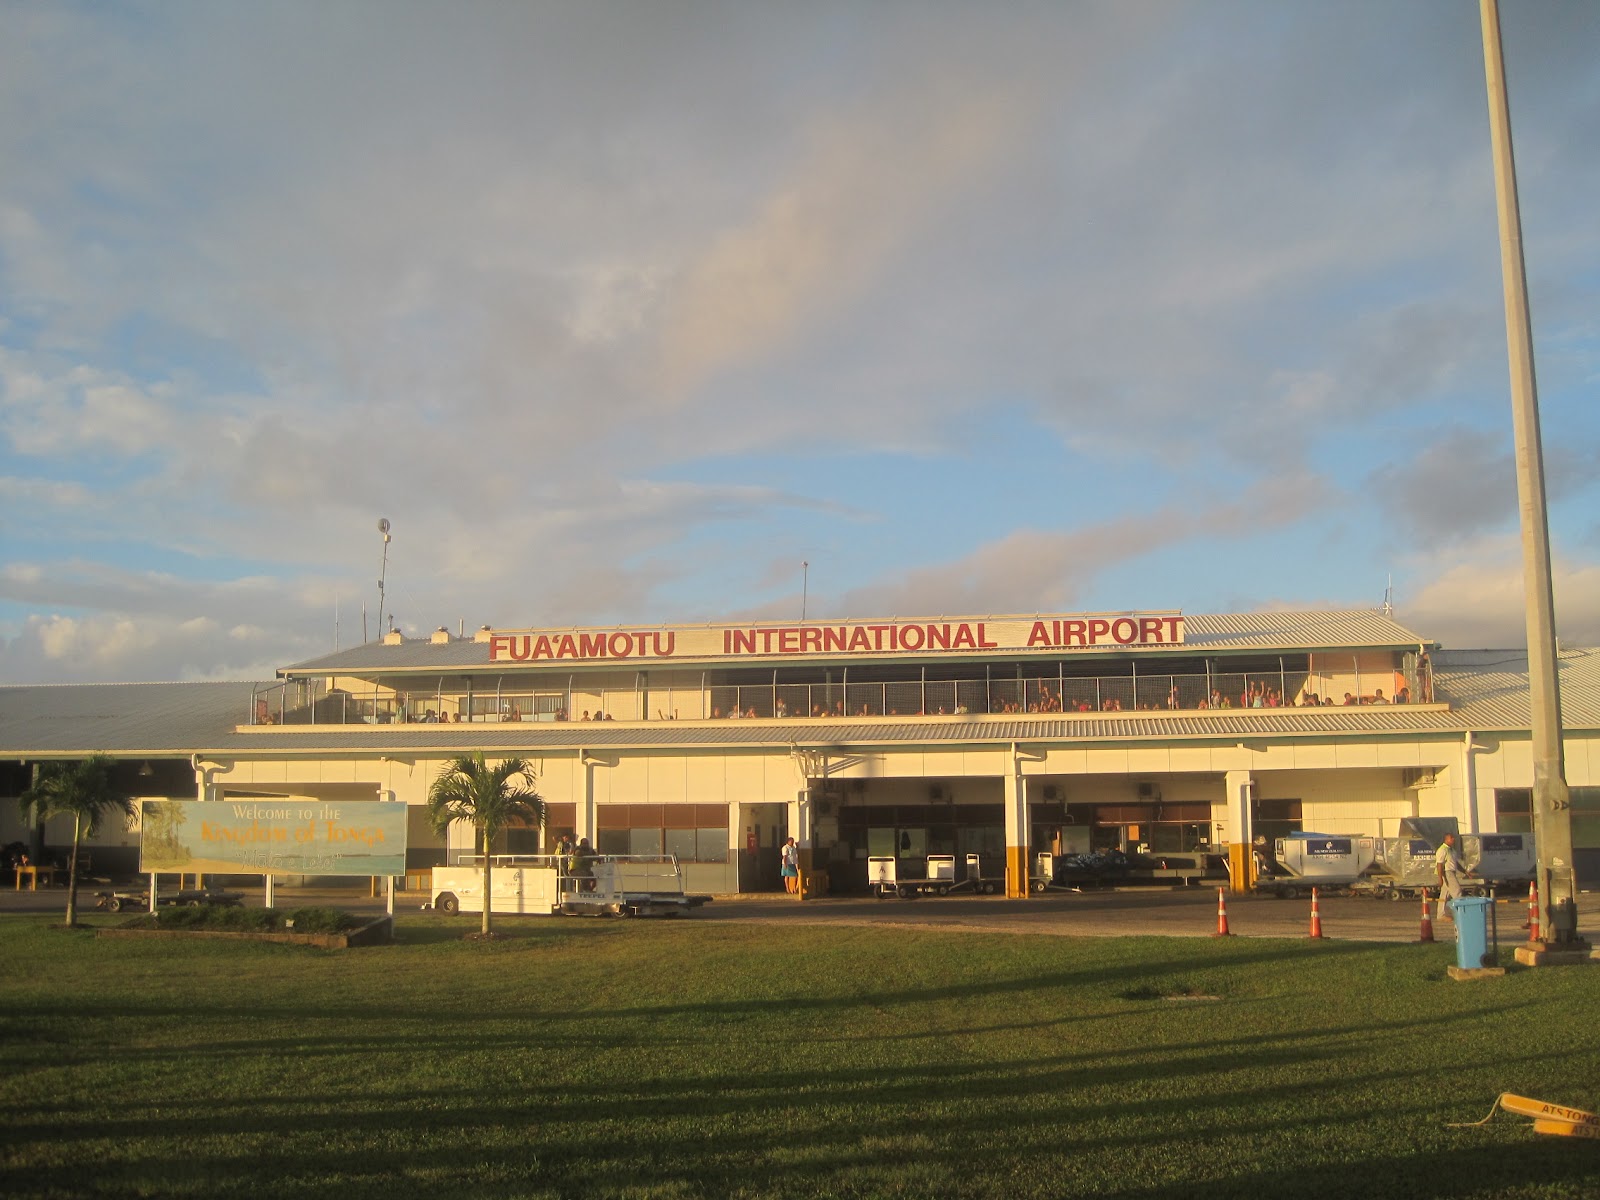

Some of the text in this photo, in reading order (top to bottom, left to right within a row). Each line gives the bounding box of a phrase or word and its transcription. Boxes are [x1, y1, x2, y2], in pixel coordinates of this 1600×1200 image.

[490, 617, 1184, 661] FUA‘AMOTU INTERNATIONAL AIRPORT
[232, 804, 291, 820] Welcome
[201, 820, 385, 848] Kingdom of Tonga
[1541, 1104, 1563, 1116] ATS
[1571, 1125, 1590, 1137] ATS
